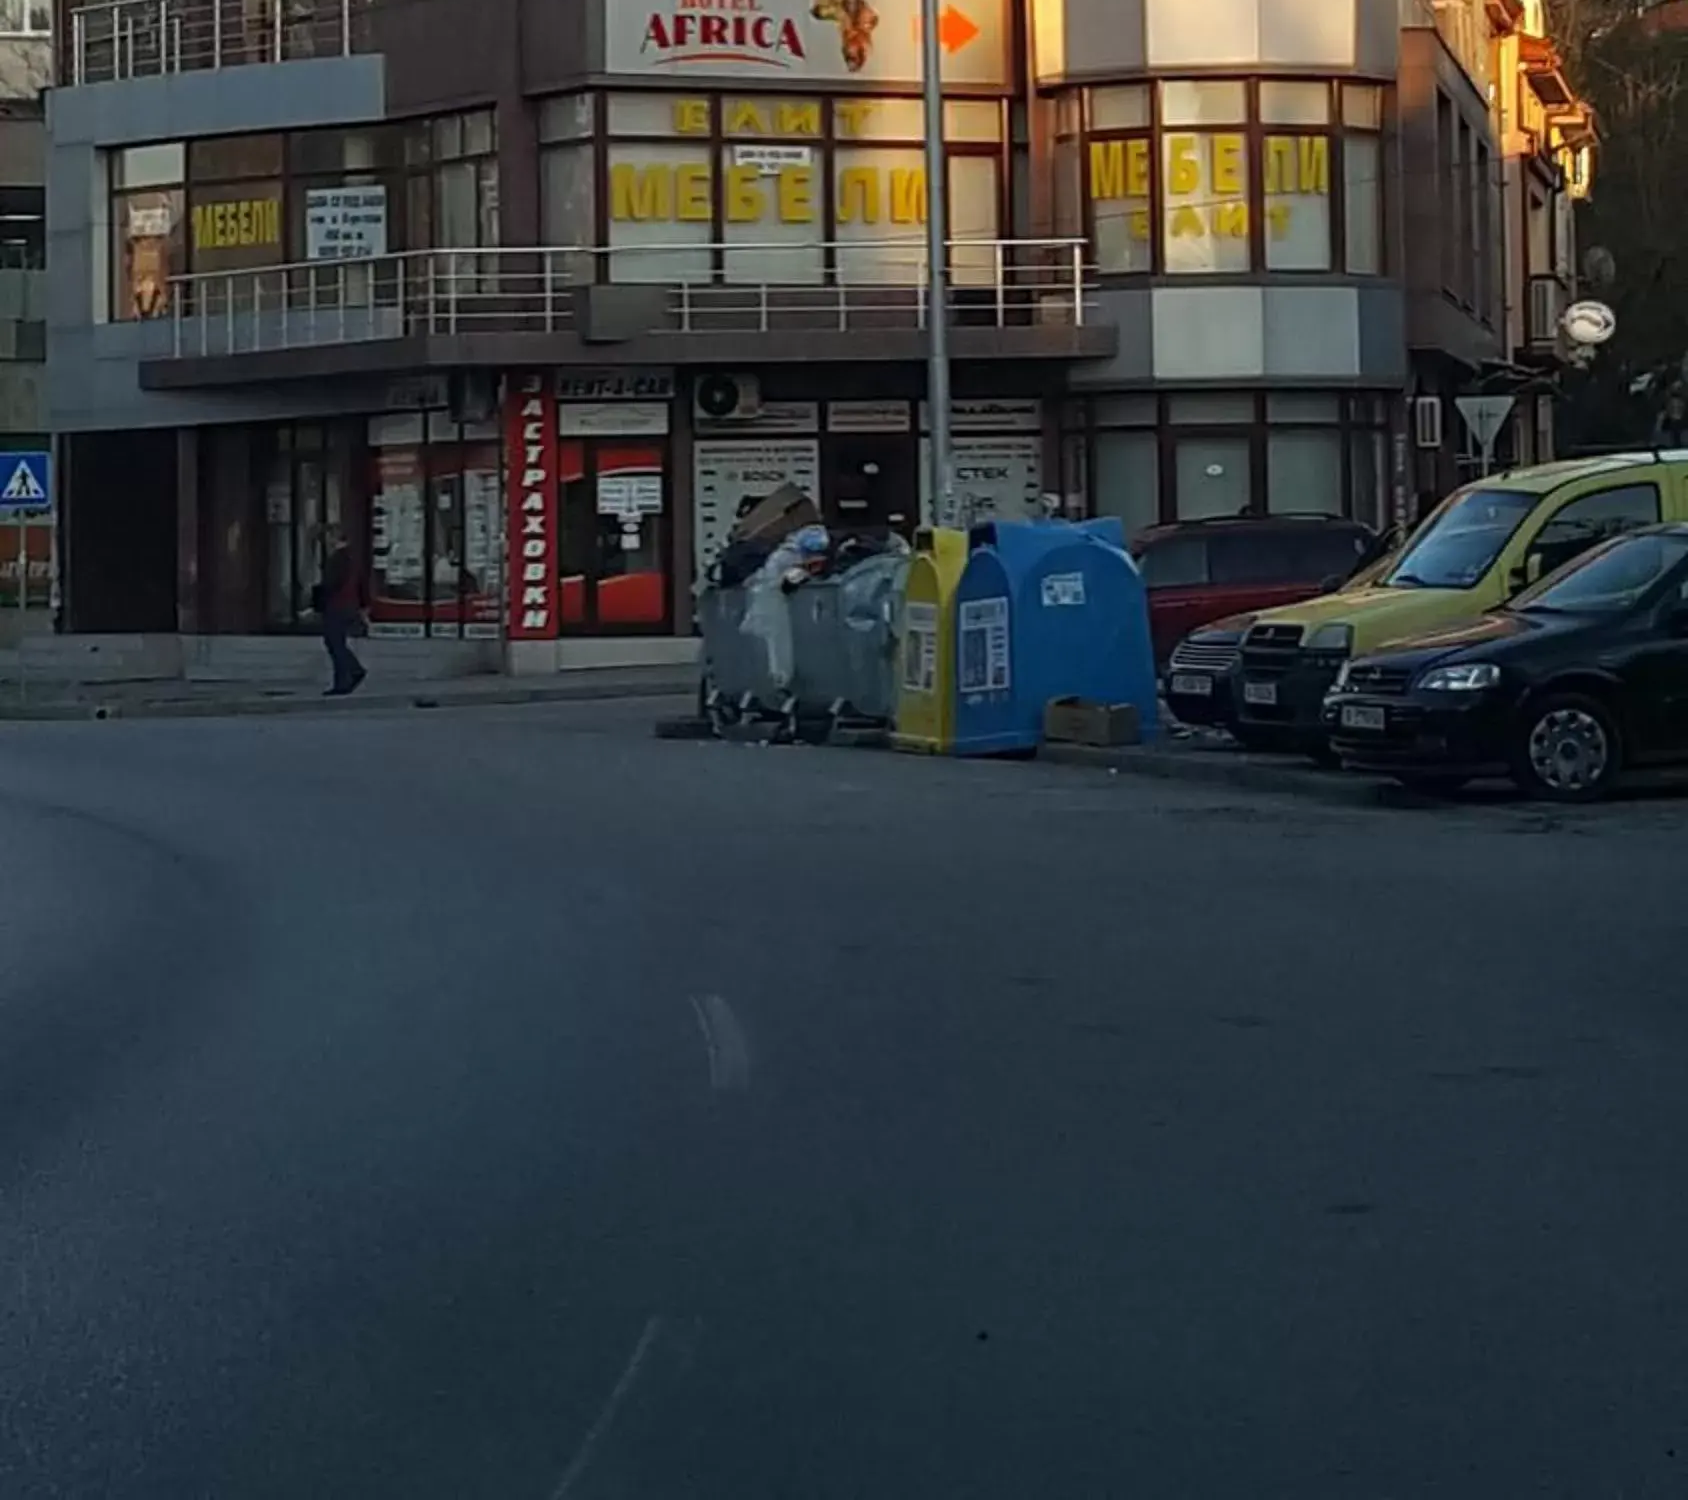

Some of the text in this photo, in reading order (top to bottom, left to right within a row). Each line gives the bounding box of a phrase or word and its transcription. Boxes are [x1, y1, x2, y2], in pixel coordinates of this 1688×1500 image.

[640, 12, 806, 61] AFRICA
[611, 163, 927, 224] МЕБЕЛИ
[1090, 136, 1328, 198] МЕБЕЛИ
[192, 198, 280, 248] МЕБЕЛИ
[521, 373, 549, 628] ЗАСТРАХОВКИ
